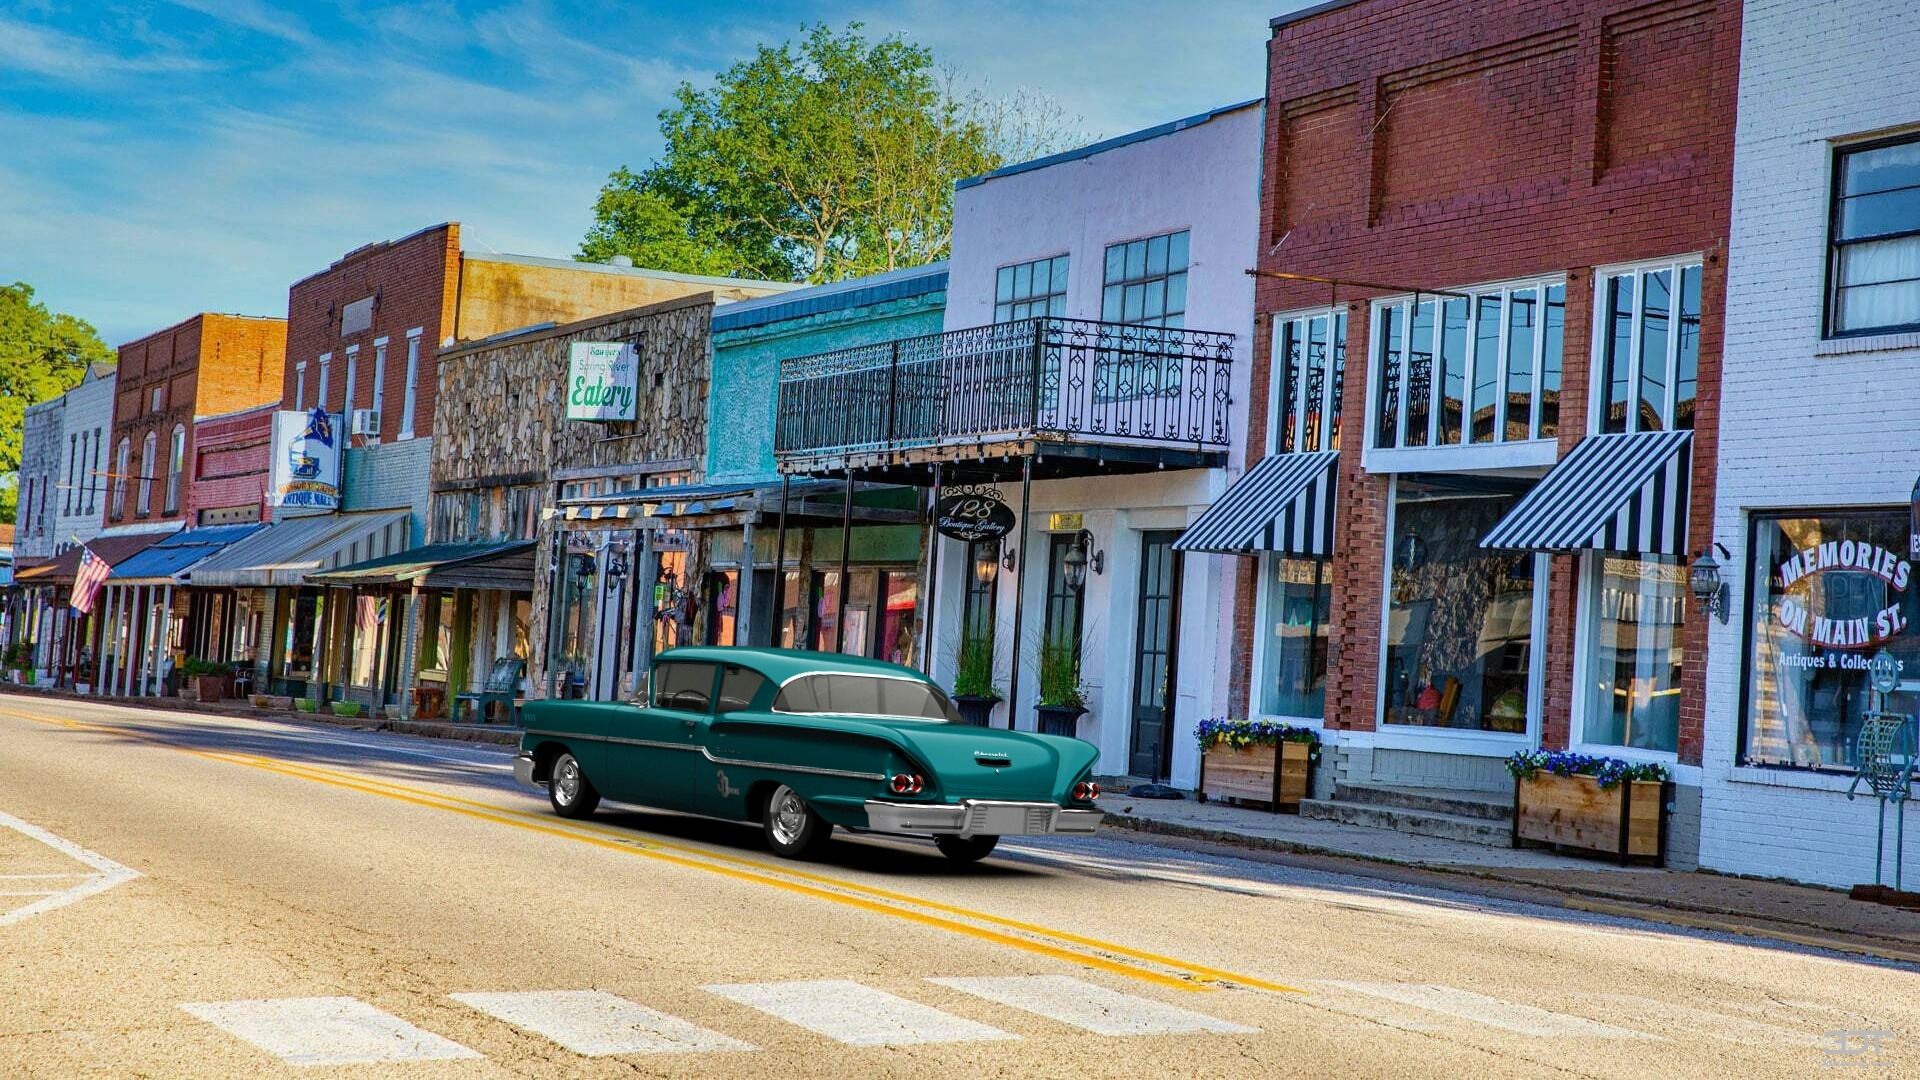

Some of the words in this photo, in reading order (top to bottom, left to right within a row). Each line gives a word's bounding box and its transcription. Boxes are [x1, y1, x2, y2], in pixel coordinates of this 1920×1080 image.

[571, 375, 633, 417] Eatery
[938, 517, 974, 531] Boutique
[975, 520, 1006, 532] Gallery
[949, 499, 996, 519] 128
[1780, 540, 1912, 592] MEMORIES
[1780, 599, 1808, 637] ON
[1811, 615, 1870, 647] MAIN
[1875, 602, 1908, 640] ST.
[1779, 652, 1825, 670] Antiques
[1828, 653, 1837, 665] &
